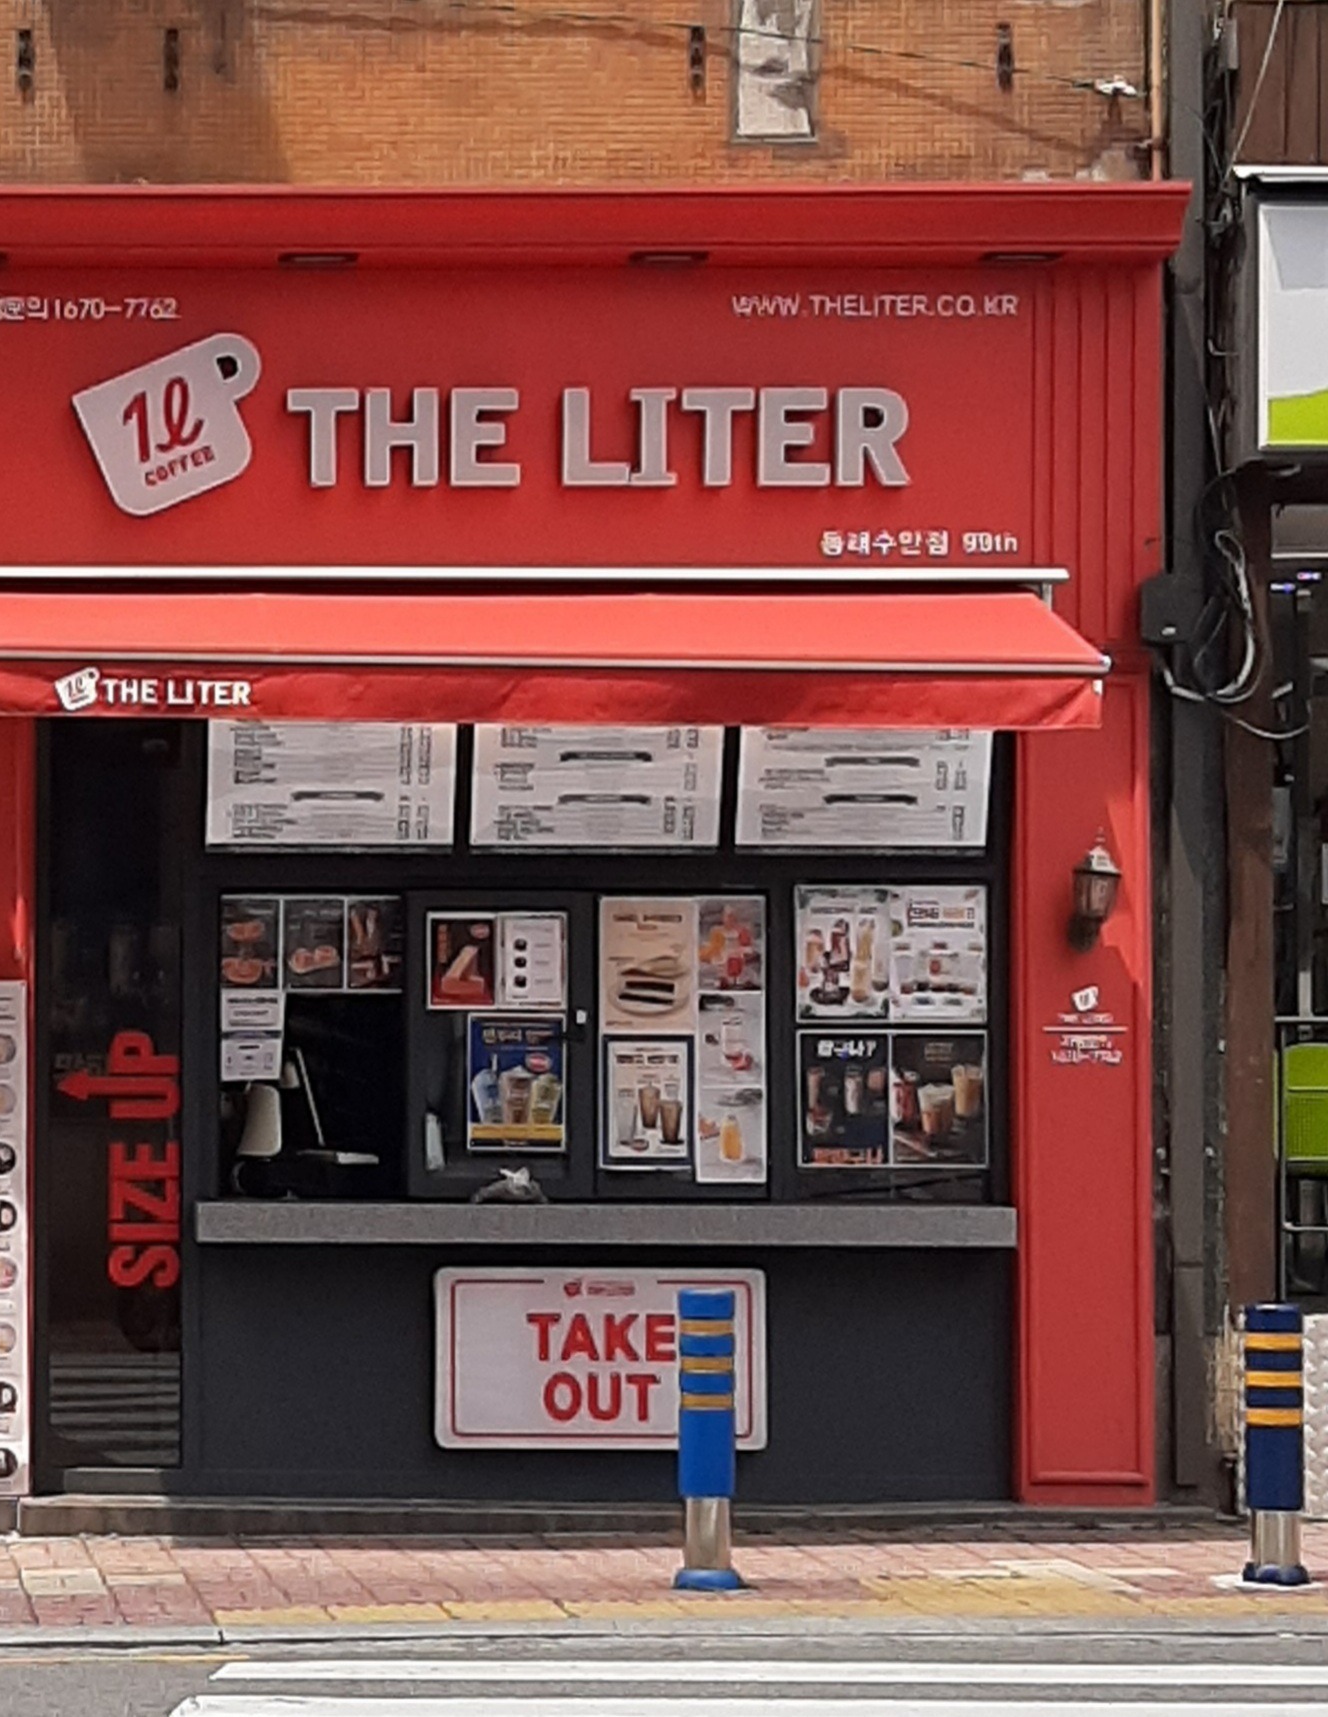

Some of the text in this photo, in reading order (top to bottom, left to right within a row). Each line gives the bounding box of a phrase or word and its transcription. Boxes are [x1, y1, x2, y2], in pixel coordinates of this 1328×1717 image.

[287, 387, 912, 488] THE LITER
[143, 445, 216, 487] COFFEE
[101, 678, 253, 706] THE LITER
[107, 1031, 180, 1288] SIZE UP
[526, 1313, 677, 1362] TAKE
[543, 1371, 662, 1423] OUT
